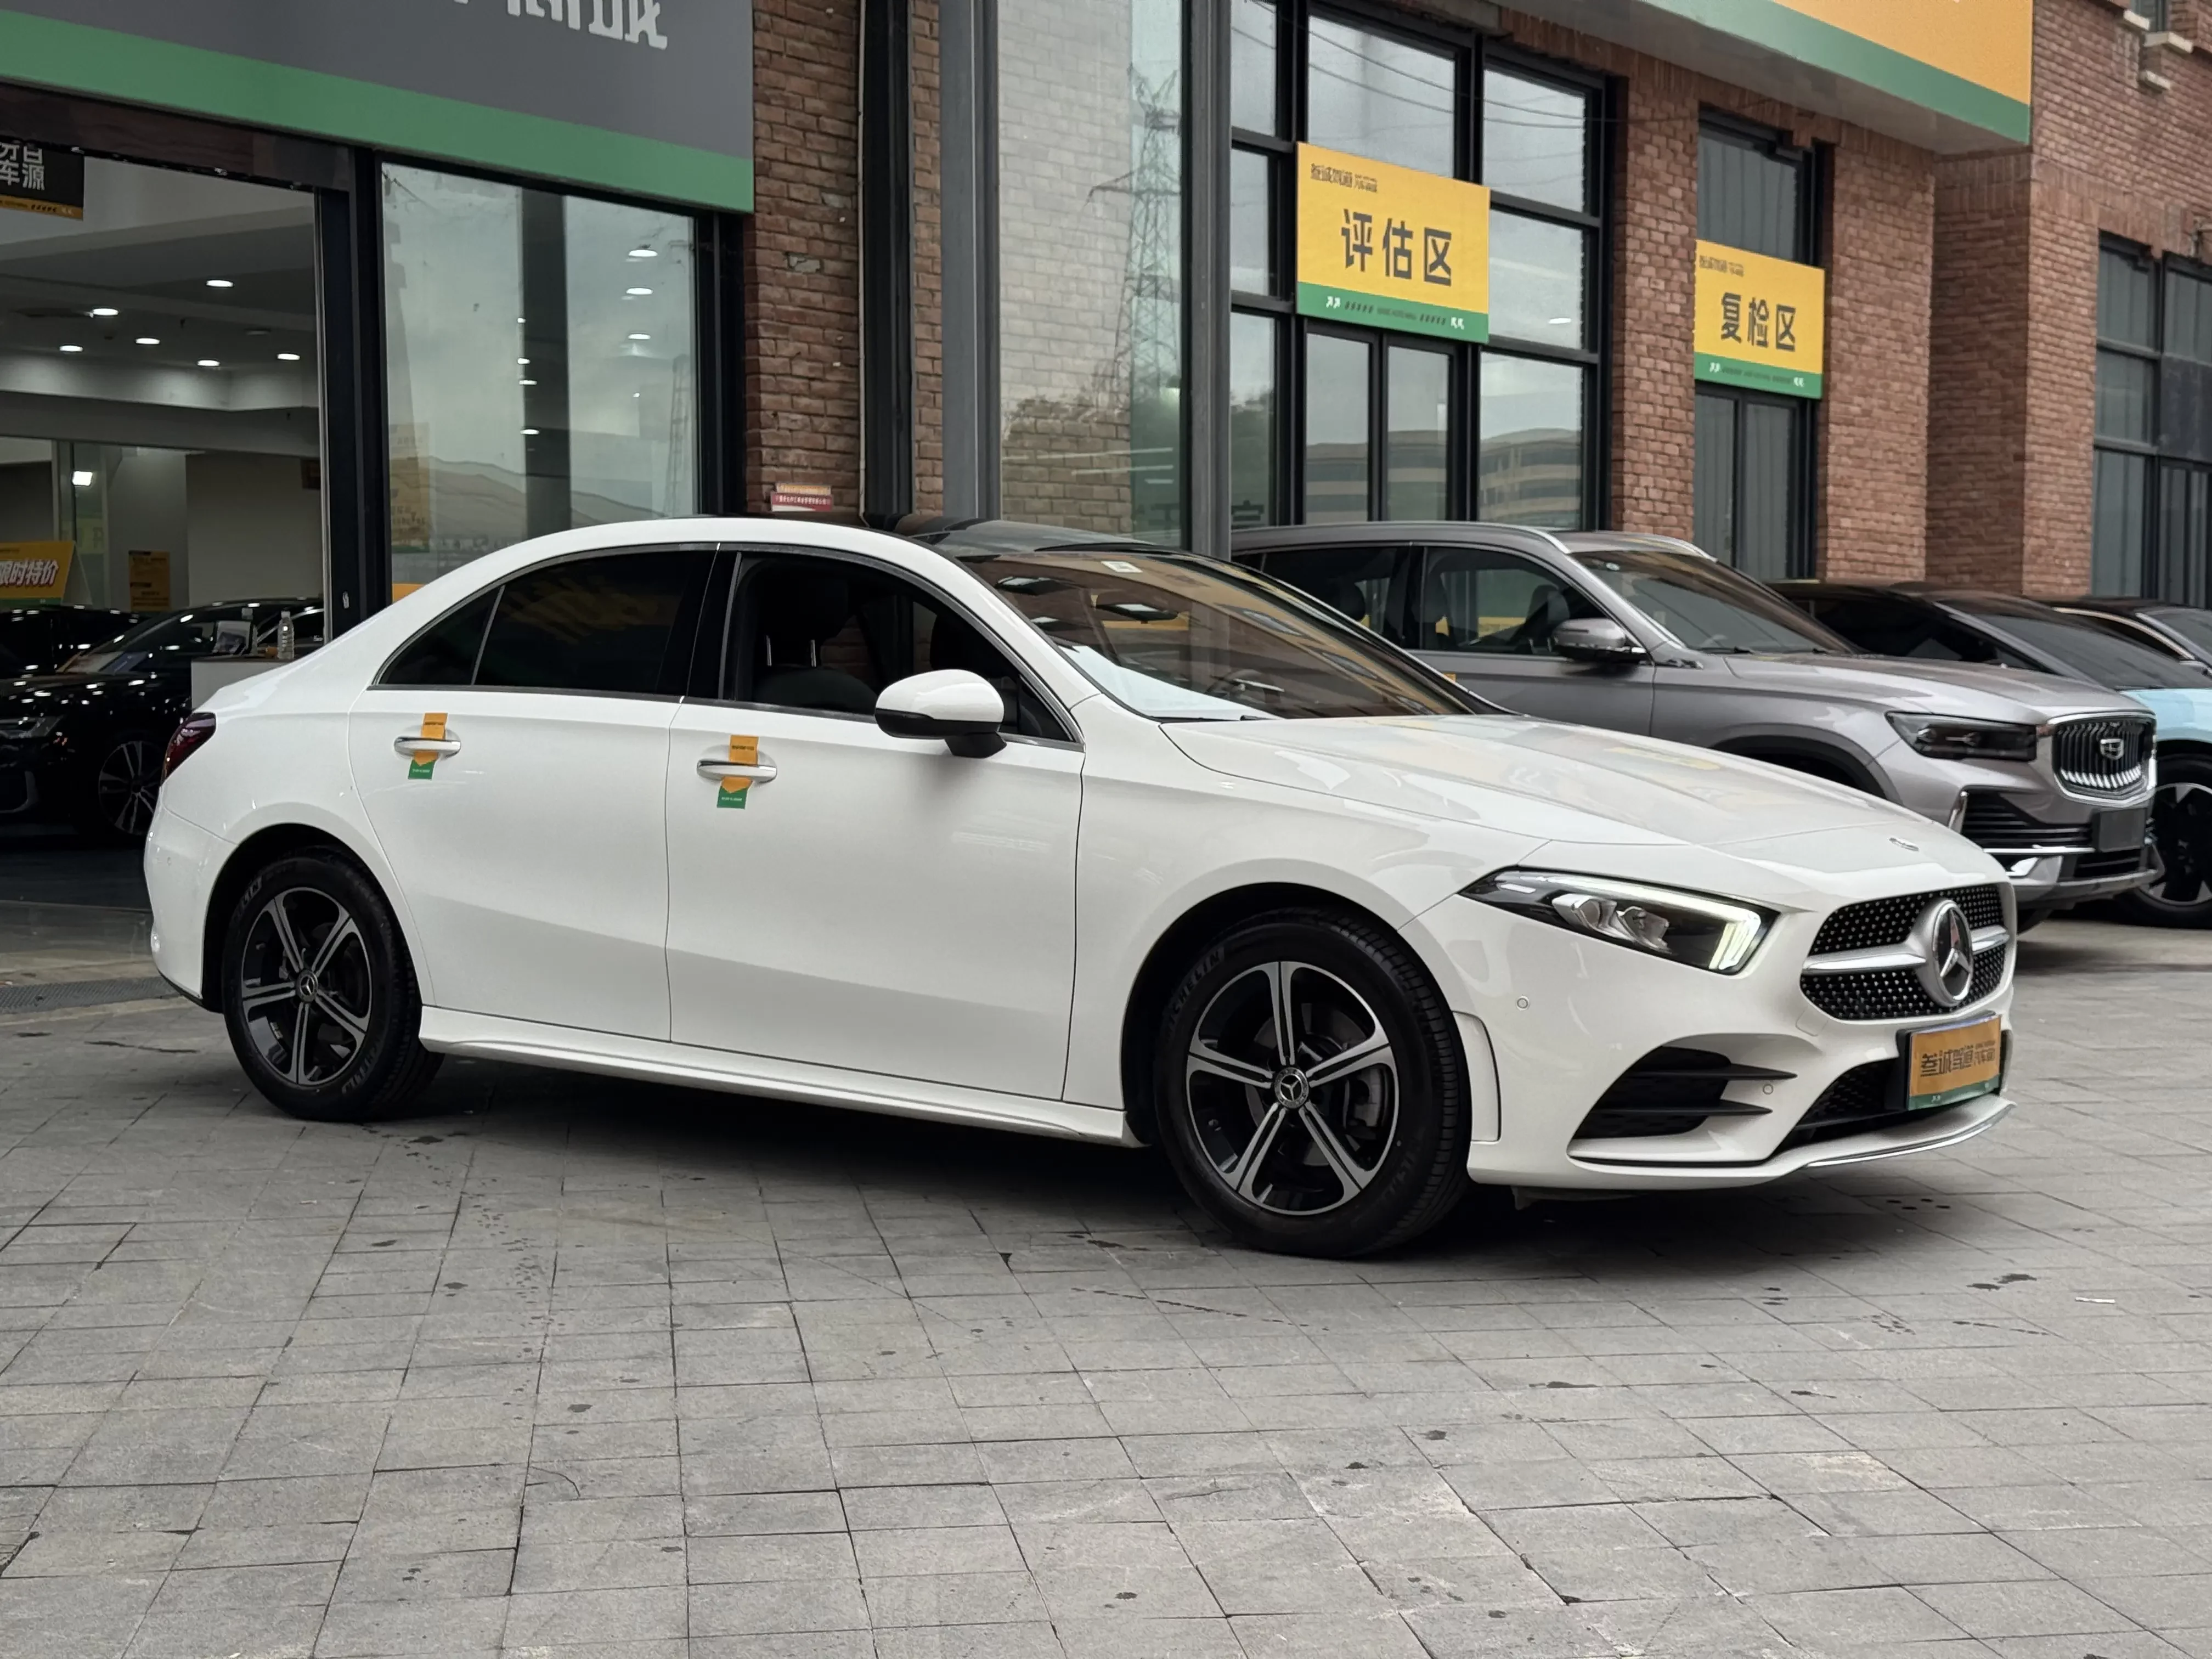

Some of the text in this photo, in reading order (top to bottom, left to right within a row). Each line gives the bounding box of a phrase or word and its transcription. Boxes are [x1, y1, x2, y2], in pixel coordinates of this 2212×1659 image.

[1341, 208, 1452, 287] 评估区
[1720, 291, 1796, 352] 复检区
[0, 559, 59, 587] 限时特价
